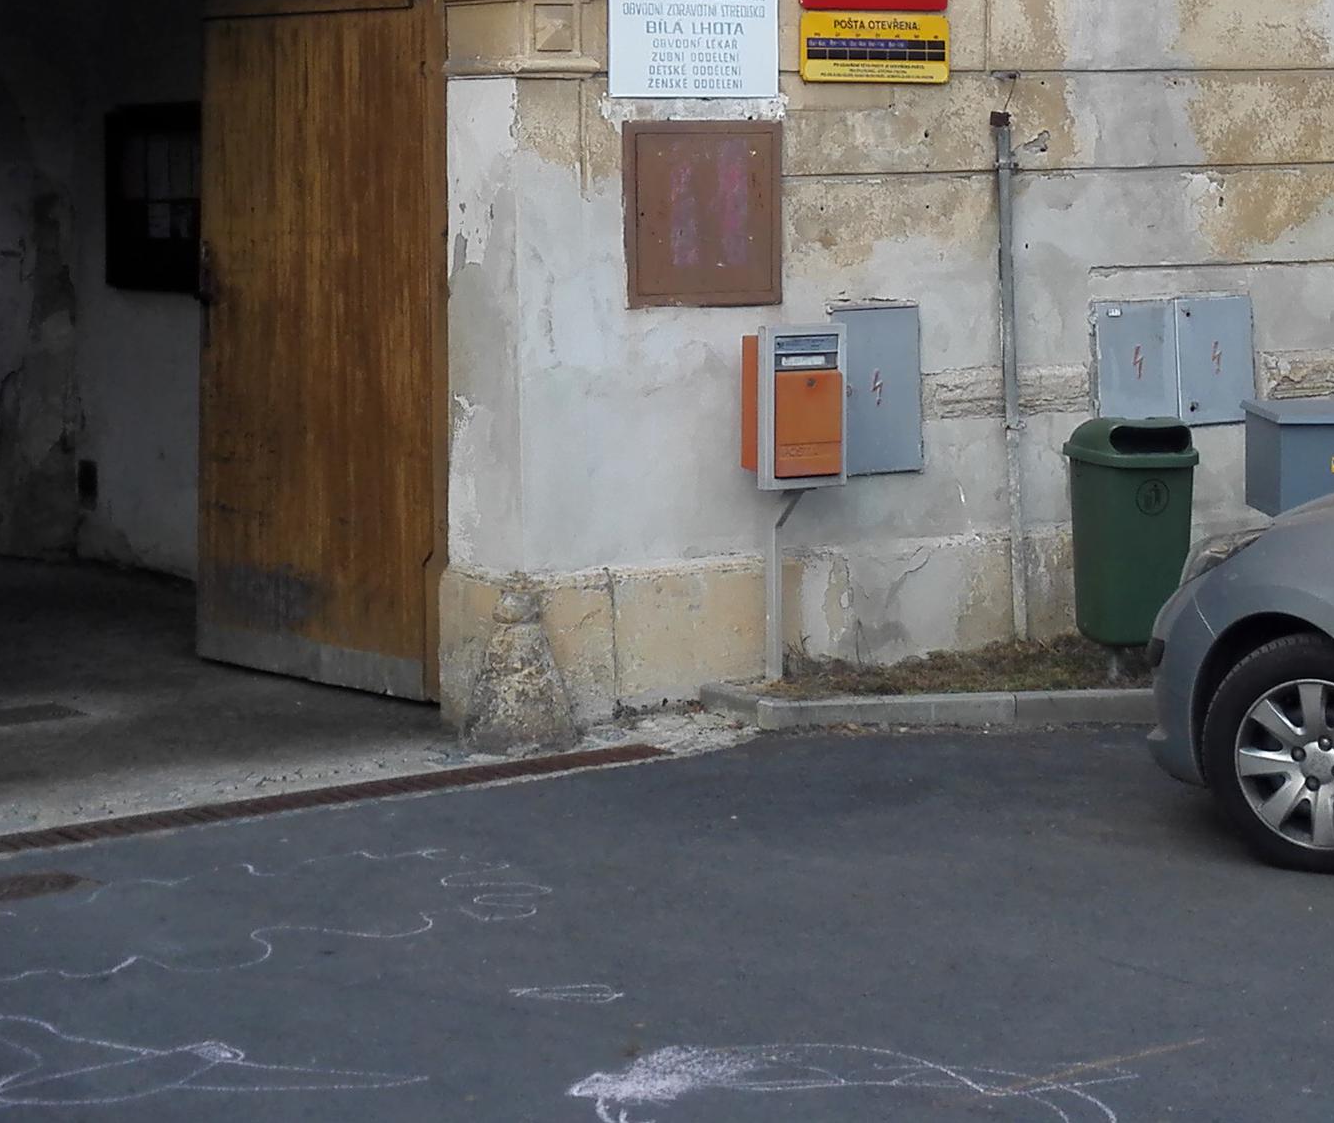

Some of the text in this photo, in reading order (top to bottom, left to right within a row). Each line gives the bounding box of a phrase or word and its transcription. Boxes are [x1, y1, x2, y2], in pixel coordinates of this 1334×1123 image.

[646, 18, 745, 36] BÍLÁ LHOTA
[833, 17, 866, 30] POŠTA
